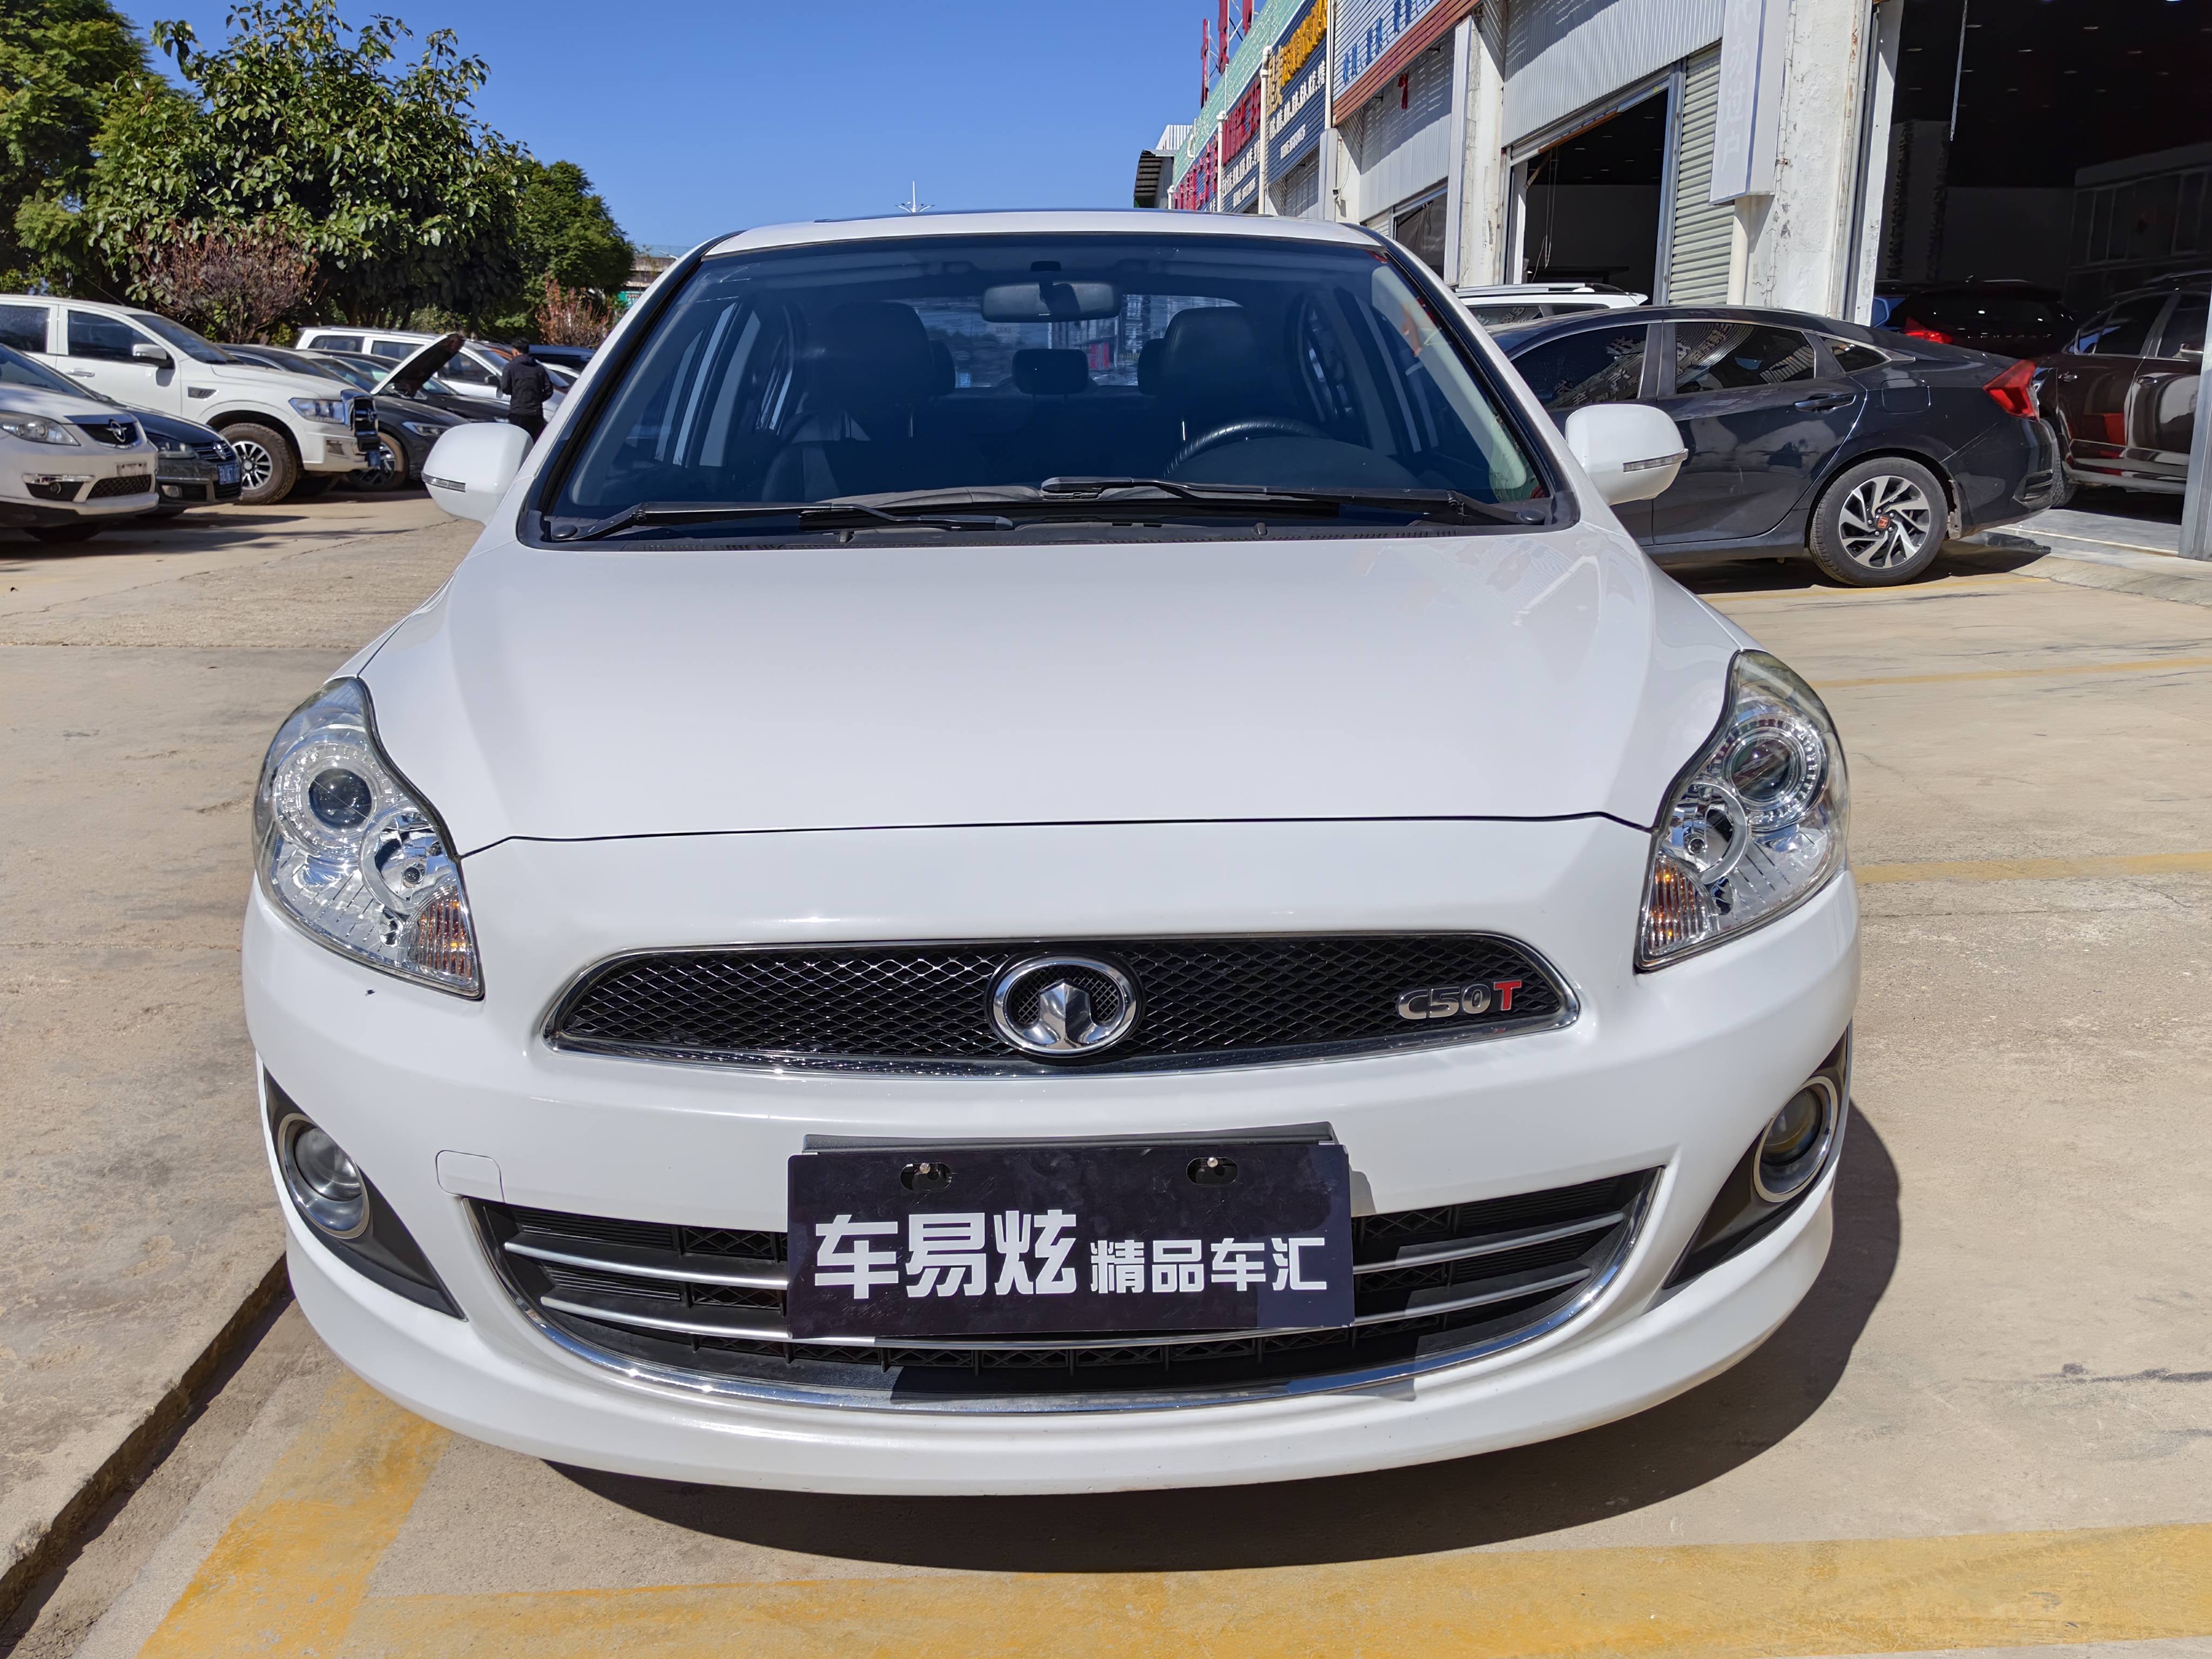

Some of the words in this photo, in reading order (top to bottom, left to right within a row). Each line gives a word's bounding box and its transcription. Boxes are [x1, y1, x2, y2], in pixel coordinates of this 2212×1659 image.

[1397, 980, 1522, 1020] C50T
[814, 1209, 1077, 1300] 车易炫
[1090, 1237, 1328, 1294] 精品车汇
